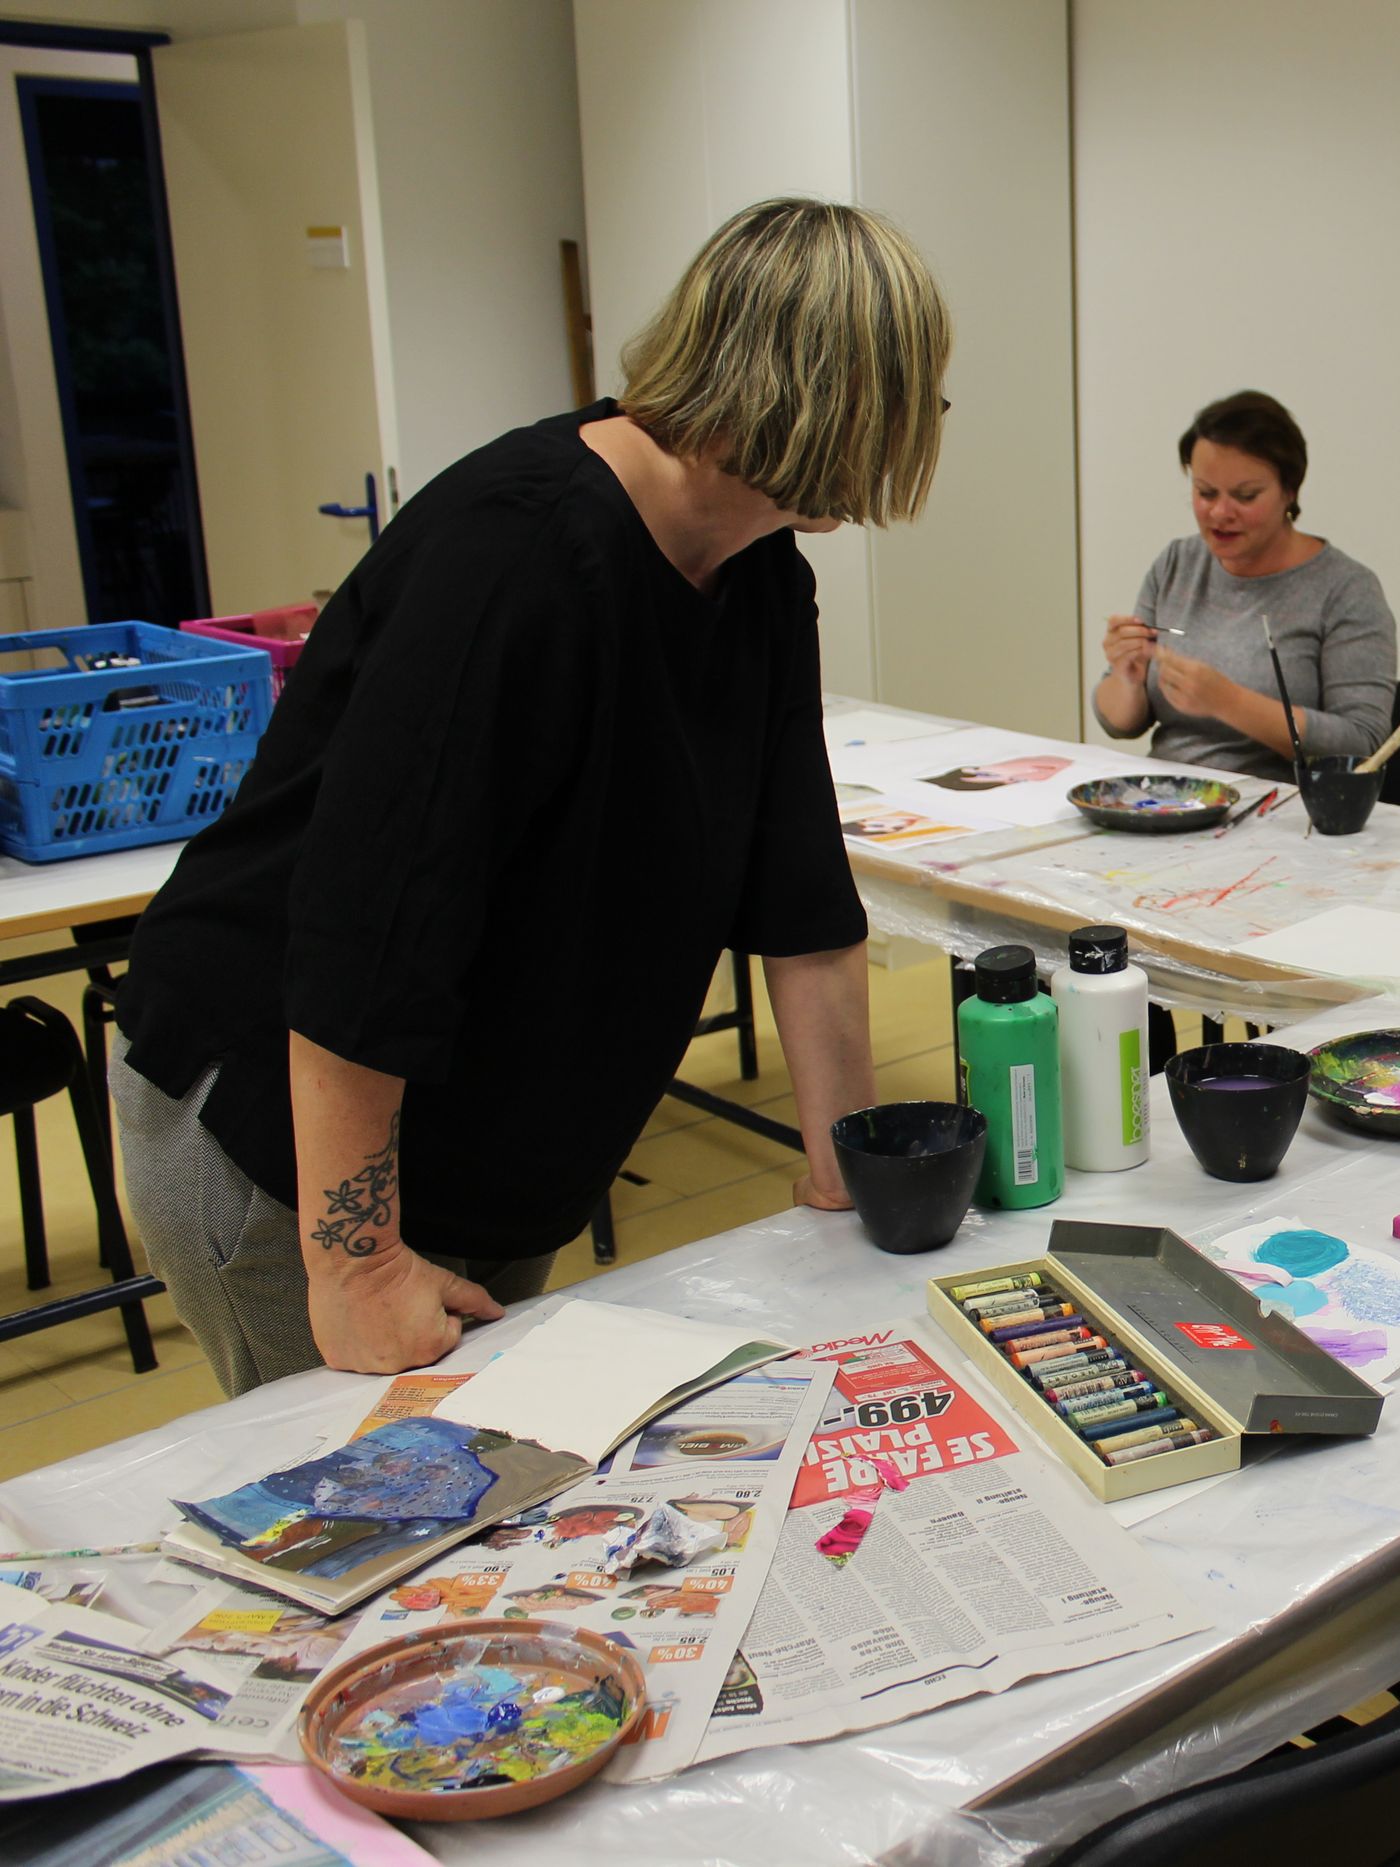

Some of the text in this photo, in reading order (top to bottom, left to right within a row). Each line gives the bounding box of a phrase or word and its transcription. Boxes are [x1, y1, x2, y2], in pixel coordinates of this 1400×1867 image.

[1129, 1066, 1143, 1144] boesner
[811, 1330, 895, 1353] Media
[801, 1423, 932, 1467] PLAISI
[822, 1431, 996, 1492] SE FARE
[462, 1574, 500, 1587] 33%
[574, 1574, 612, 1587] 40%
[711, 1567, 736, 1577] 1.05
[689, 1579, 729, 1591] 40%
[657, 1647, 698, 1660] 30%
[1, 1657, 59, 1684] Kinder
[53, 1673, 136, 1712] flüchten
[130, 1702, 185, 1728] ohne
[15, 1690, 43, 1712] in
[35, 1695, 71, 1718] die
[70, 1703, 151, 1739] Schweiz
